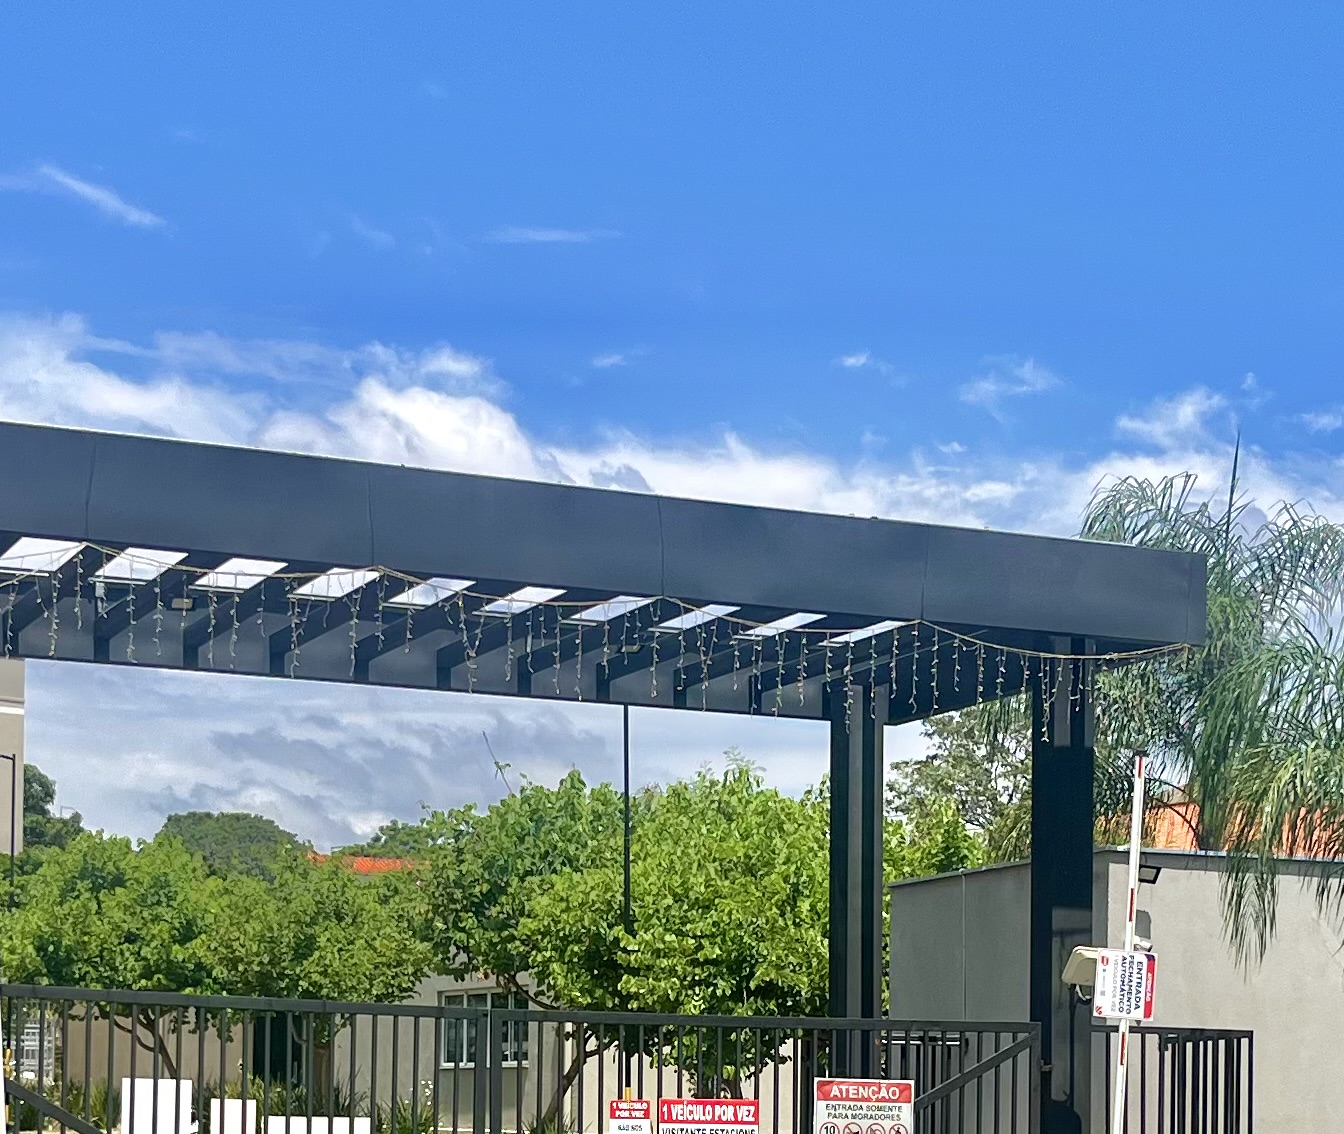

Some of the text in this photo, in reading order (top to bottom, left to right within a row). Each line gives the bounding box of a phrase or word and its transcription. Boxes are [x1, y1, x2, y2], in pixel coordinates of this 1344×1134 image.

[1126, 955, 1134, 1014] FECHAMENTO
[1134, 961, 1143, 1010] ENTRADA
[829, 1083, 900, 1101] ATENÇÃO
[662, 1100, 755, 1121] 1 VEÍCULO POR VEZ
[826, 1103, 863, 1112] ENTRADA
[827, 1112, 901, 1121] PARA MORADORES
